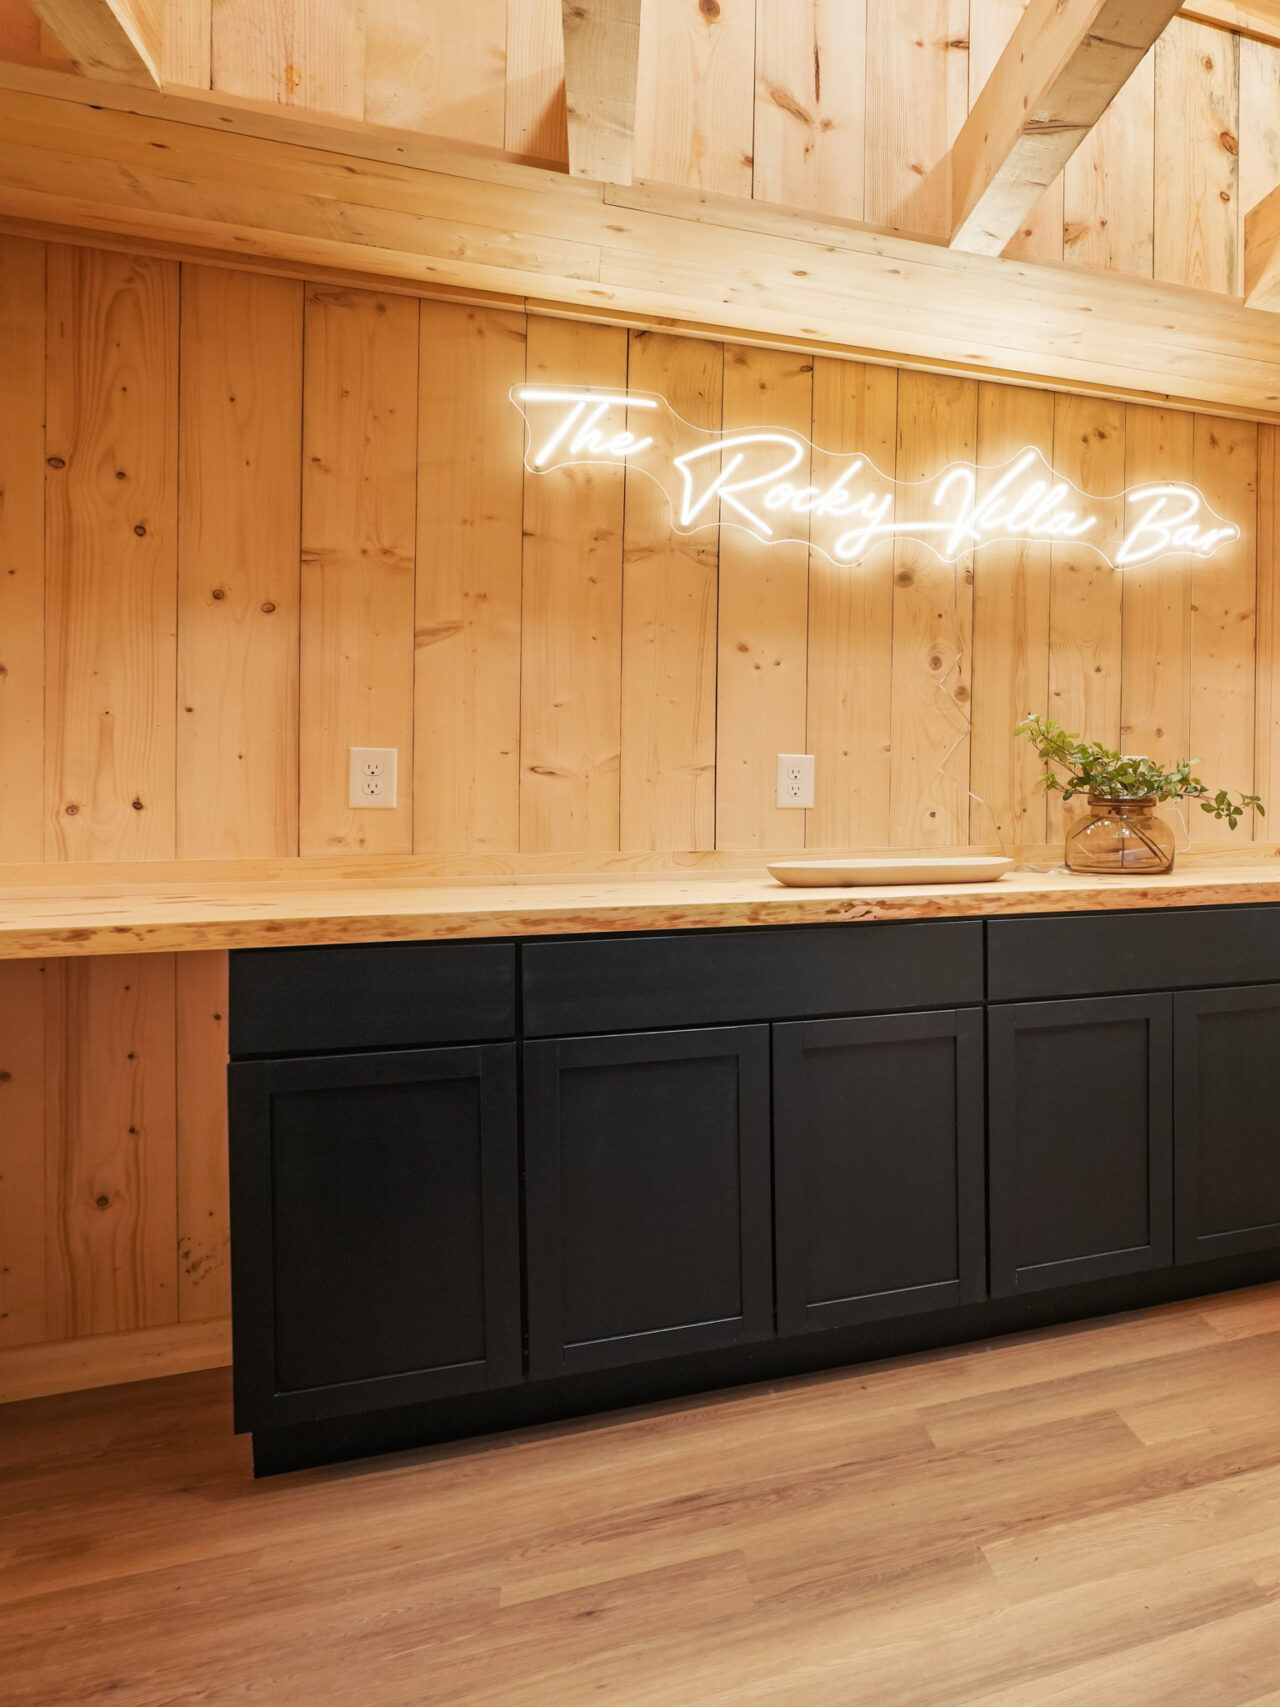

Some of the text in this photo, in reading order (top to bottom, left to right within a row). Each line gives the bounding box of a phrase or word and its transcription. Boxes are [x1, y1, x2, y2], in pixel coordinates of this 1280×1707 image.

[519, 389, 1238, 564] The Rocky Villa Bar
